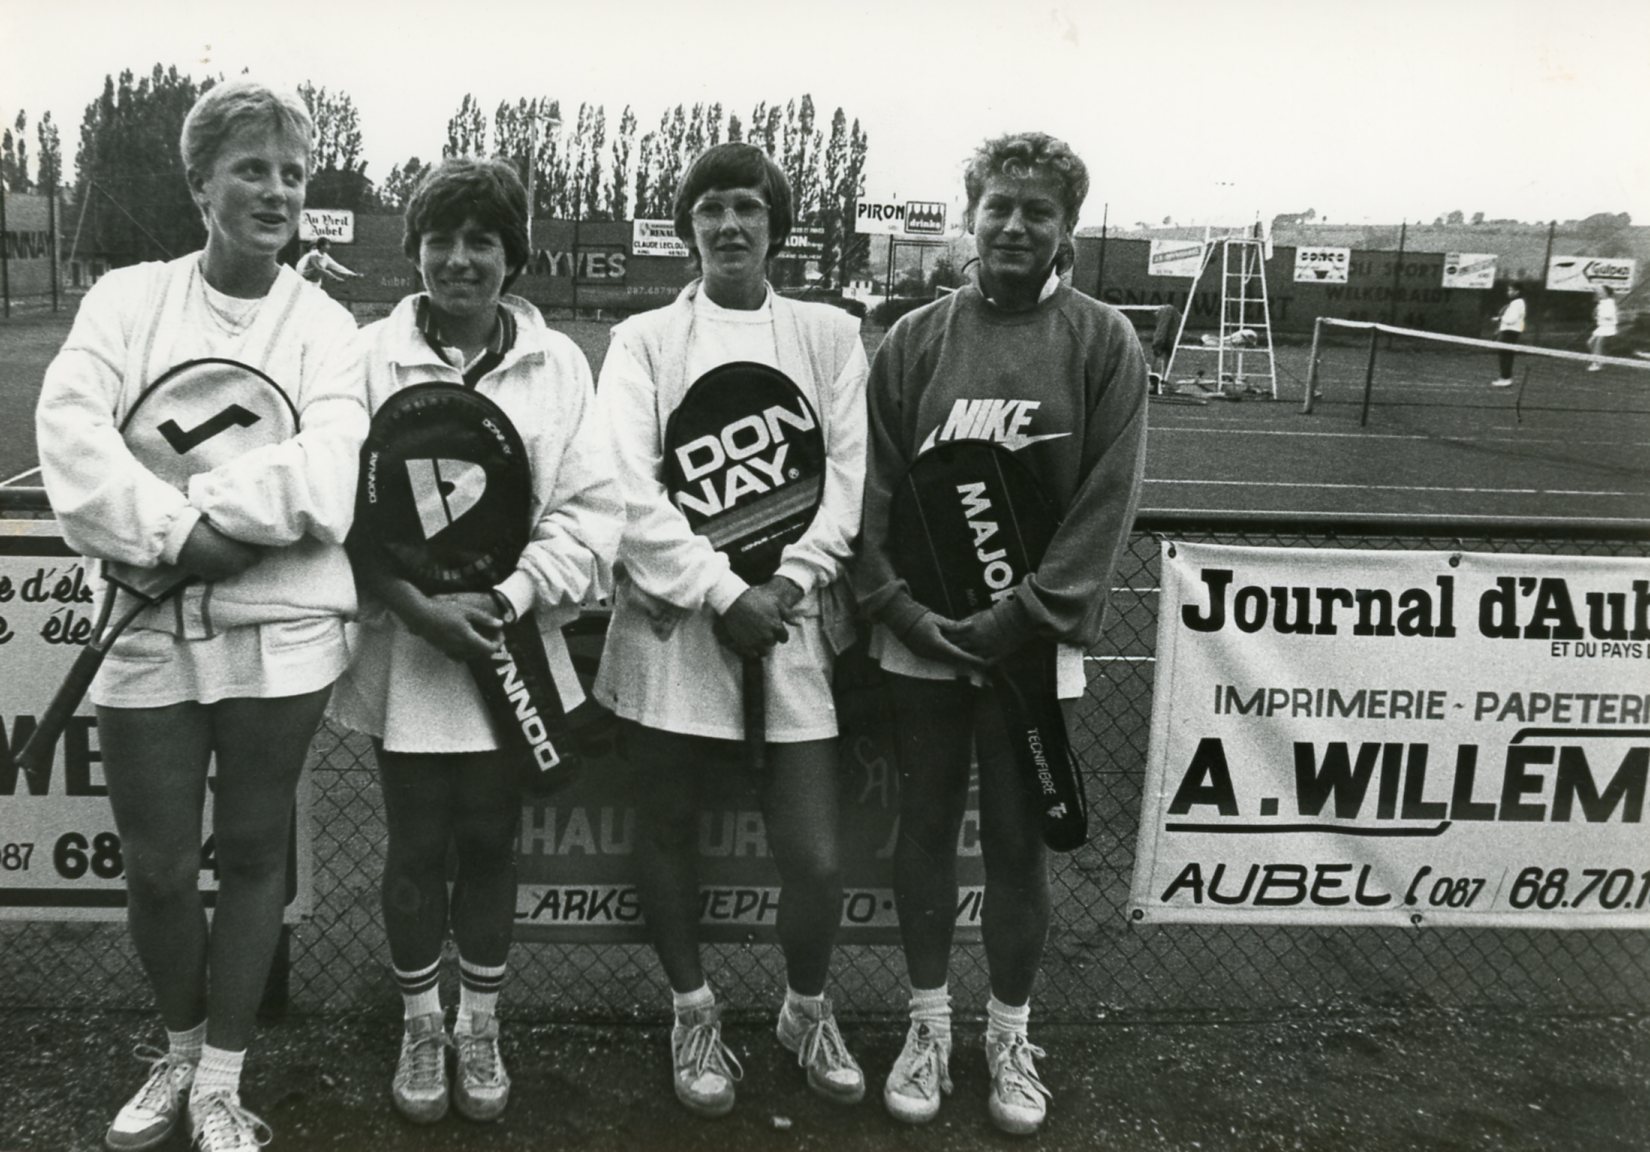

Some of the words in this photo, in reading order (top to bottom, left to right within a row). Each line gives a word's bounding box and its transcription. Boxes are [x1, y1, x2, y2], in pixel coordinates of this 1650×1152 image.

[309, 224, 343, 236] Aubel
[858, 203, 905, 221] PIRON
[909, 217, 941, 229] drinks
[675, 395, 816, 483] DON
[938, 398, 1042, 443] NIKE
[367, 451, 379, 504] DONNAY
[1181, 567, 1456, 639] Journal
[1551, 641, 1570, 657] ET
[1574, 641, 1597, 658] DU
[1601, 642, 1643, 659] PAYS
[1214, 684, 1447, 720] IMPRIMERIE
[1026, 727, 1057, 795] TECNIFIBRE
[1293, 741, 1650, 823] WILLEM
[1160, 862, 1392, 906] AUBEL
[1428, 876, 1487, 908] 087
